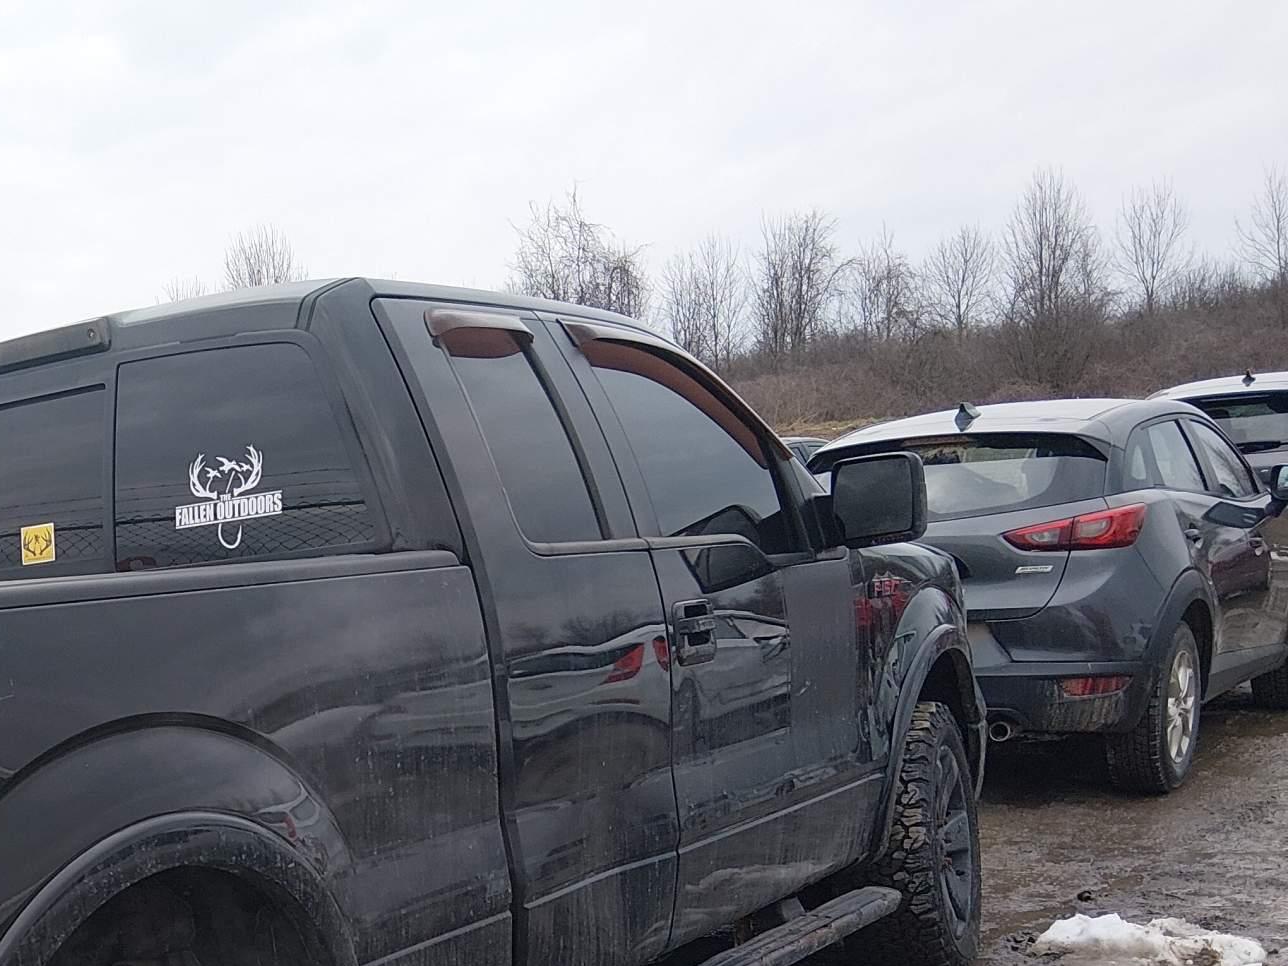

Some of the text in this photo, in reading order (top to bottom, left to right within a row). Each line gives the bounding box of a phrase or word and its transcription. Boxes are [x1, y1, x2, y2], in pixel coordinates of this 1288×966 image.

[219, 493, 232, 502] THE
[175, 493, 283, 527] FALLEN OUTDOORS
